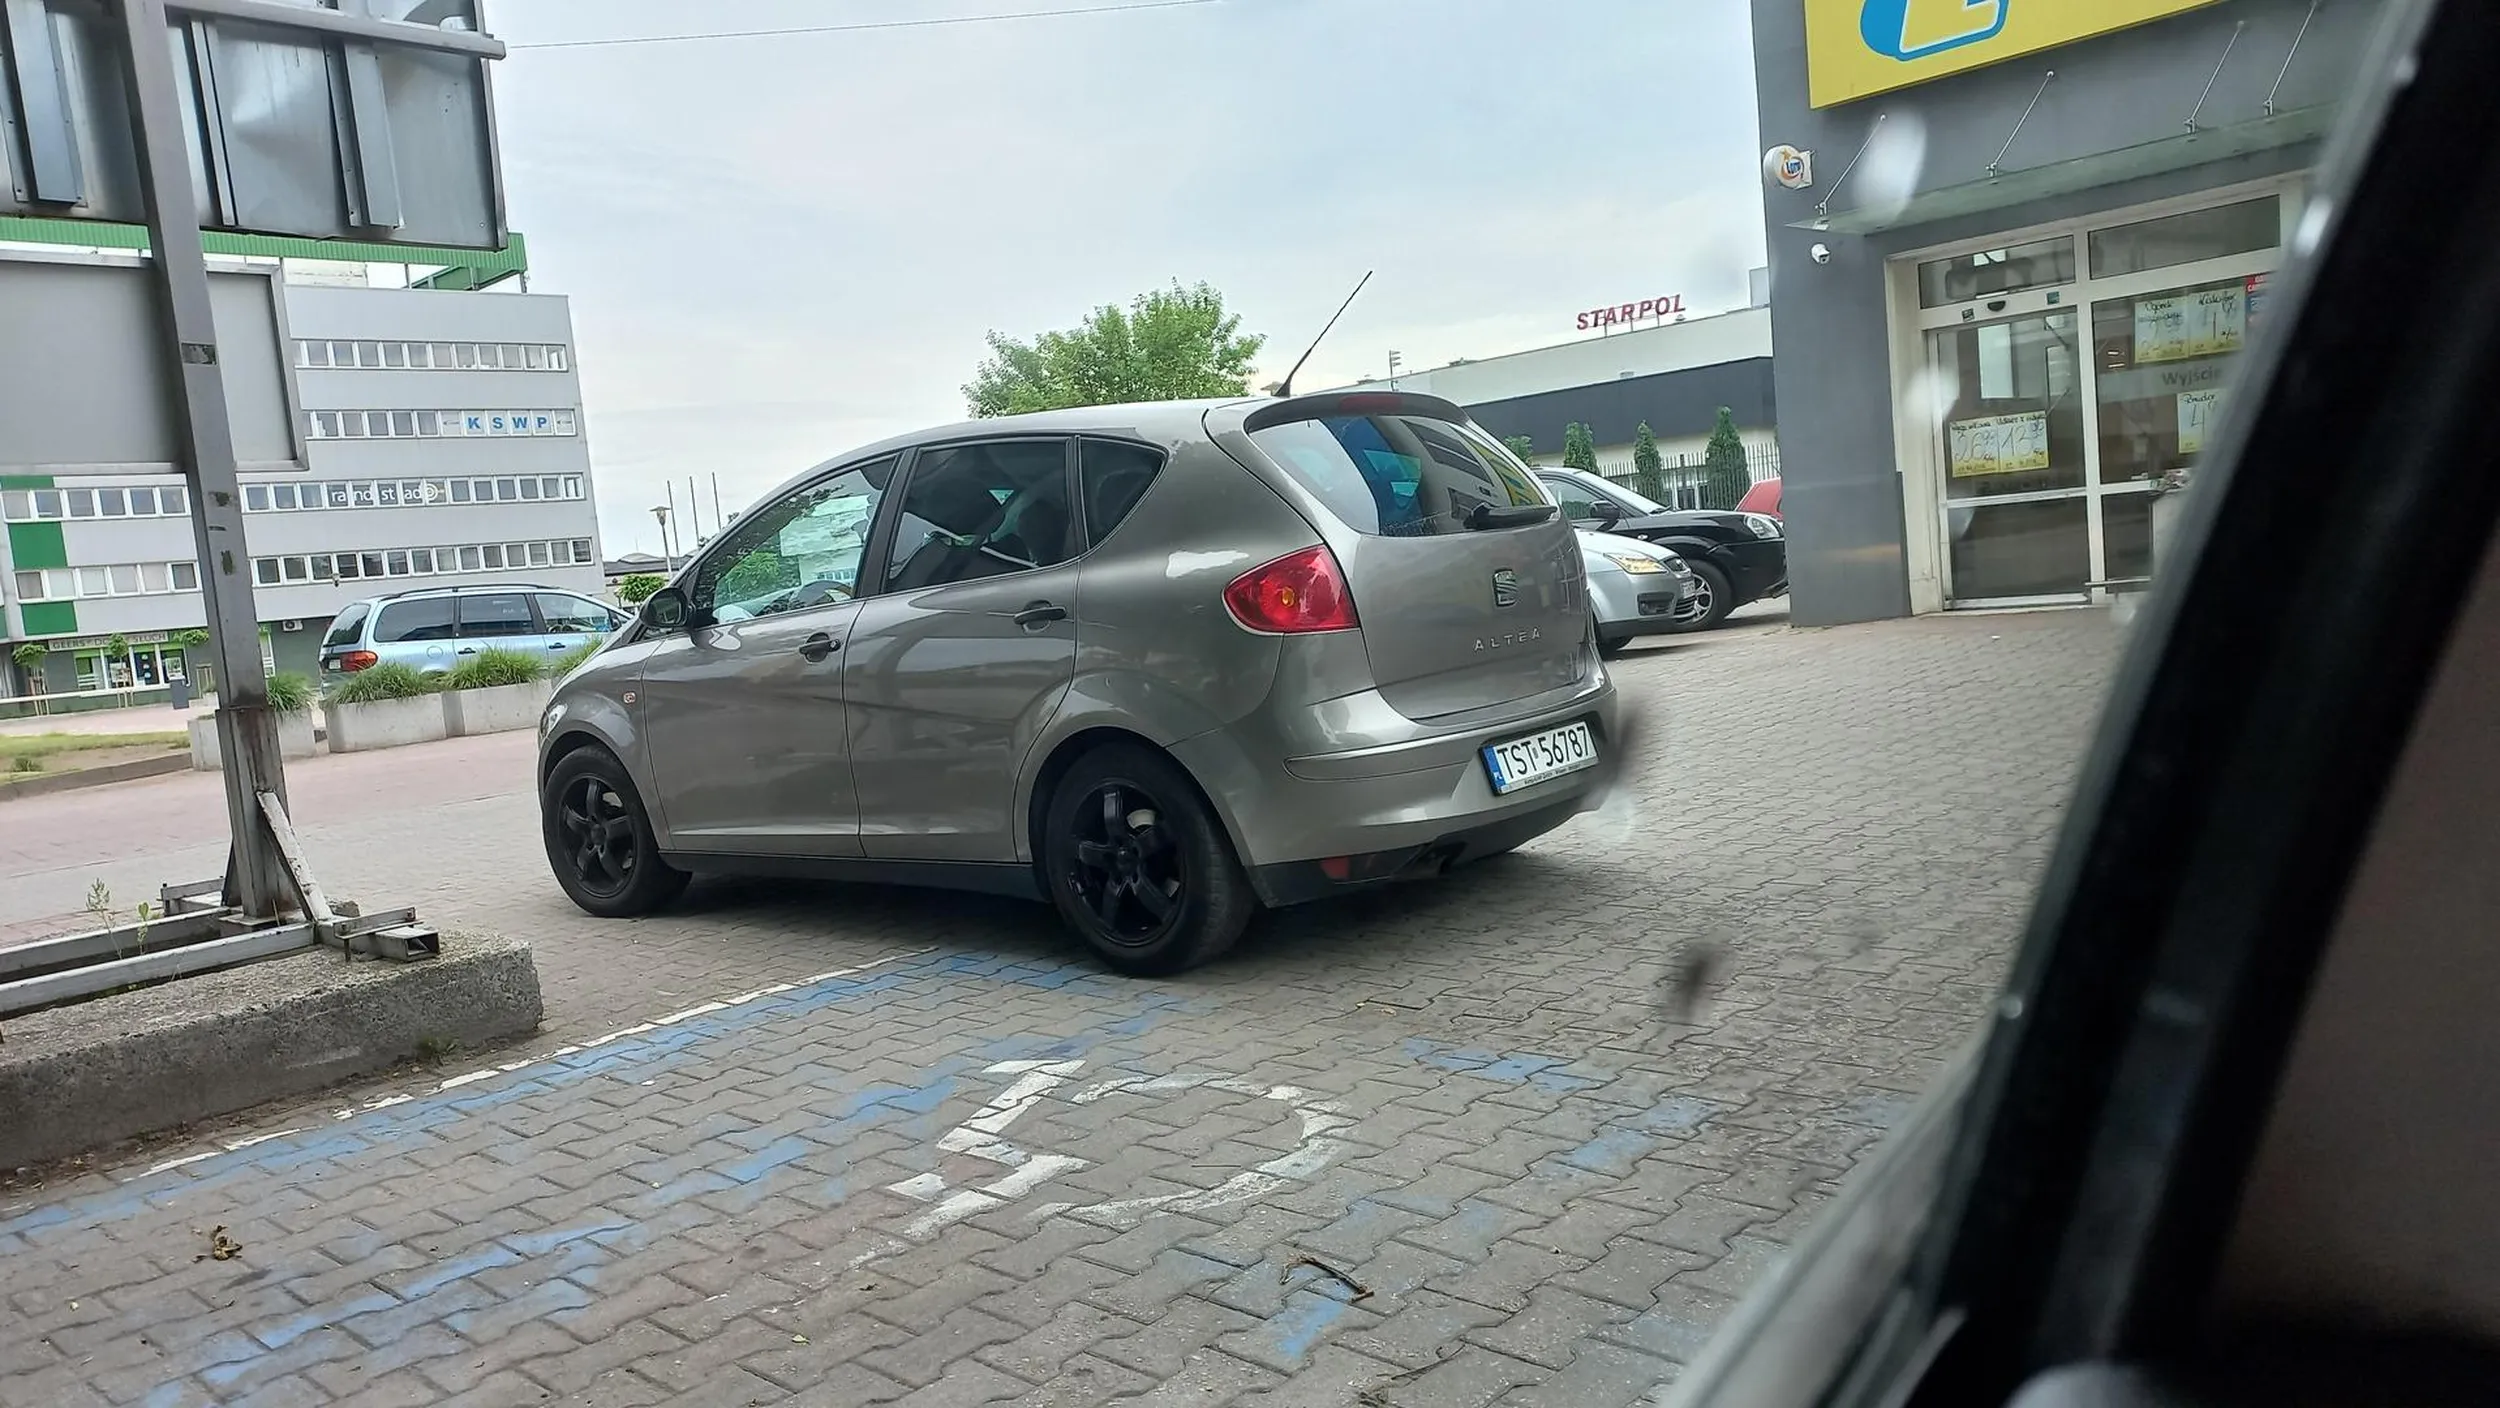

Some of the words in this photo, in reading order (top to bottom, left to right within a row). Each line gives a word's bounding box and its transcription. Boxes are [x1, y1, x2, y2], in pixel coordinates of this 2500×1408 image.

[1577, 294, 1686, 330] STARPOL
[468, 417, 547, 429] KSWP
[1474, 628, 1540, 651] ALTEA
[1497, 741, 1538, 779] TST
[1537, 726, 1589, 767] 56787
